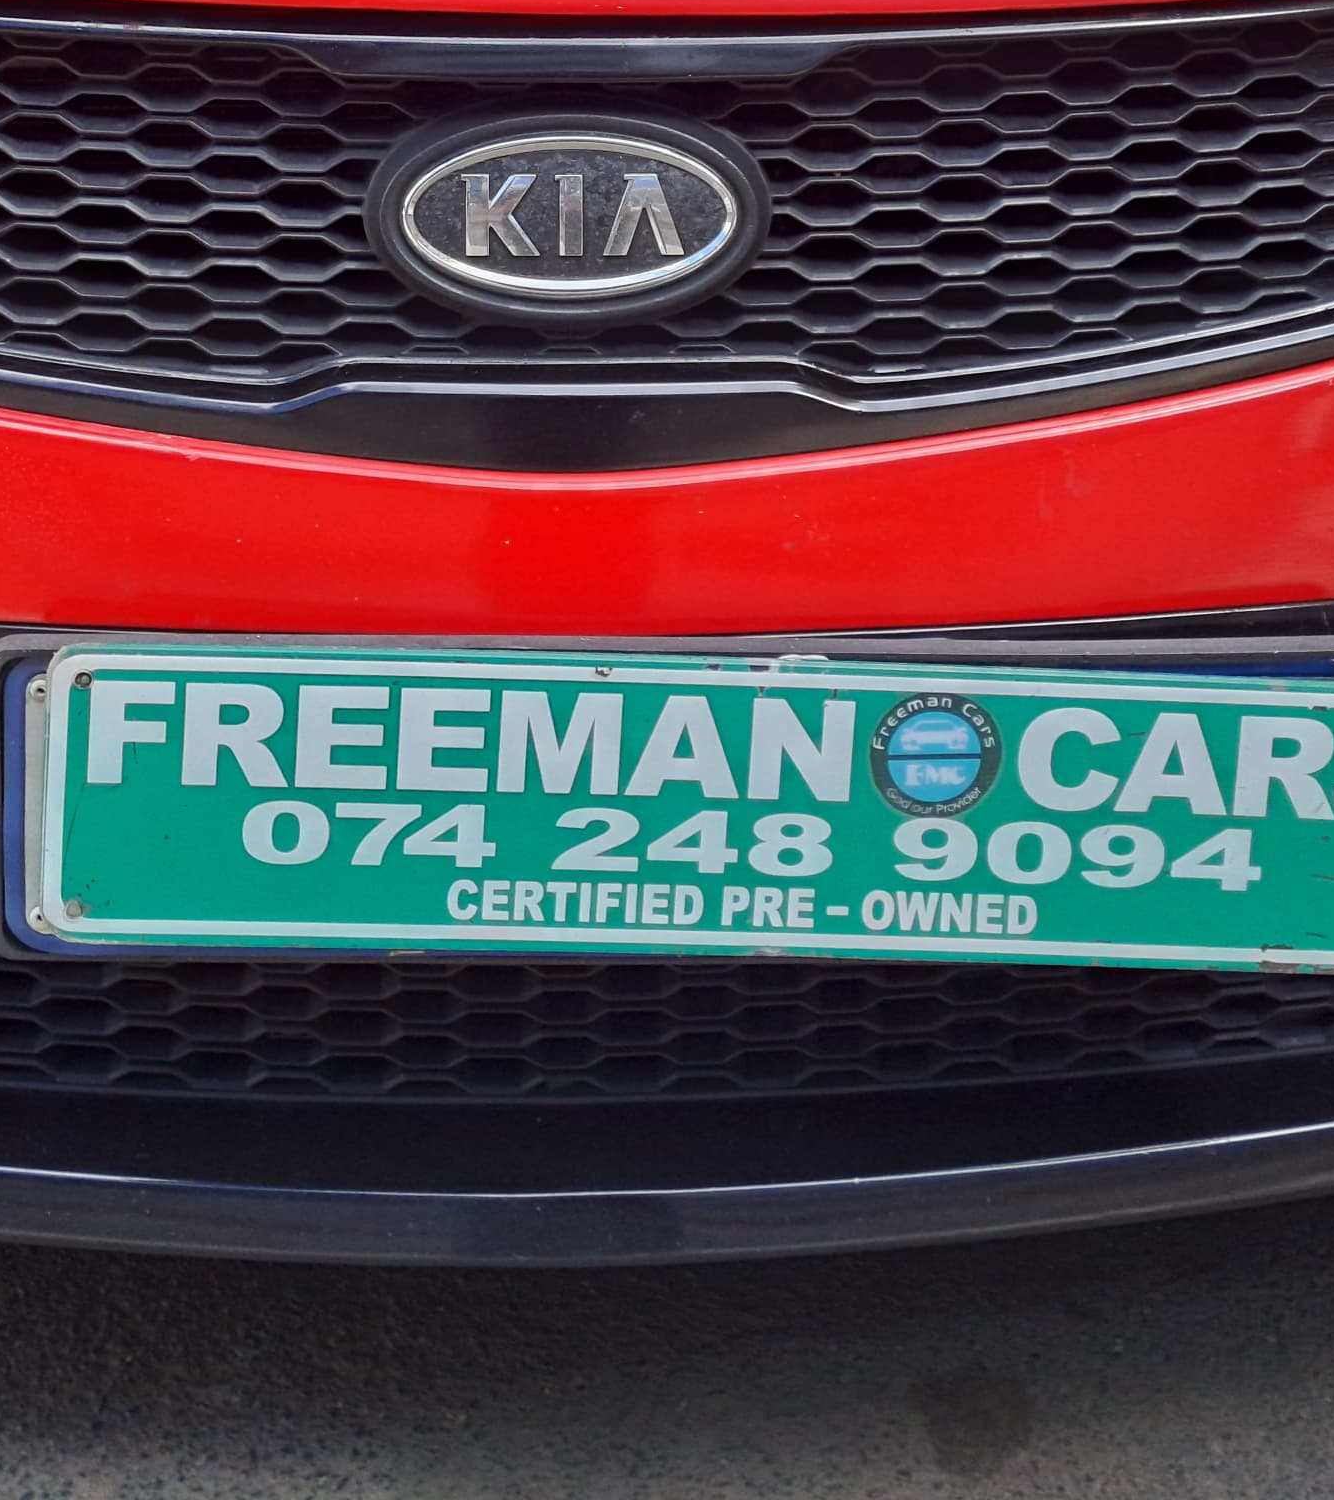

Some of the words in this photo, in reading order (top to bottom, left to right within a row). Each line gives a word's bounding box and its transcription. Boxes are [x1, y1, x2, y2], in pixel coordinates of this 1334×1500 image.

[460, 173, 685, 258] KIA
[85, 680, 857, 804] FREEMAN
[872, 696, 953, 751] Freeman
[962, 703, 996, 749] Cars
[885, 787, 911, 810] God
[910, 803, 934, 815] our
[935, 786, 984, 814] Provider
[241, 799, 497, 869] 074
[550, 807, 835, 879] 248
[892, 819, 1263, 892] 9094
[446, 878, 706, 927] CERTIFIED
[721, 885, 816, 929] PRE
[861, 889, 1039, 935] OWNED
